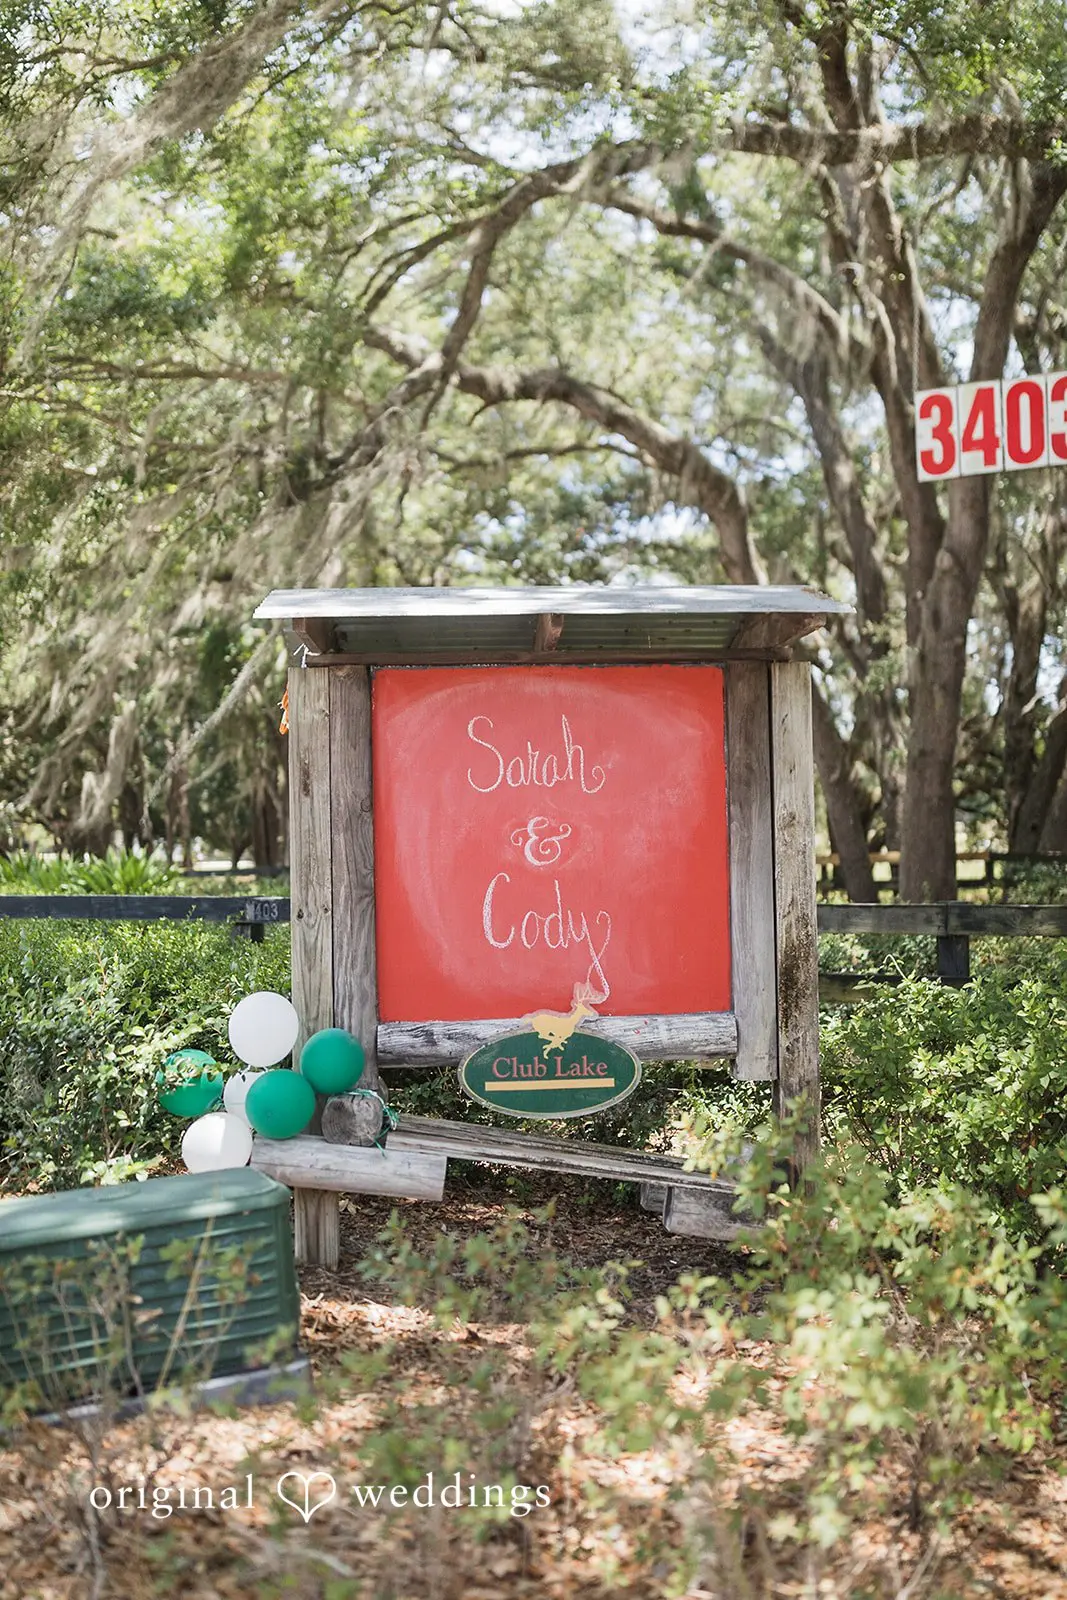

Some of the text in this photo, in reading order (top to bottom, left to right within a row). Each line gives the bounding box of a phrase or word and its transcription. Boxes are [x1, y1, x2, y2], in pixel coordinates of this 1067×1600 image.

[467, 714, 605, 793] Sarah
[510, 816, 571, 866] &
[482, 872, 611, 1004] Cody
[492, 1055, 608, 1078] Club Lake
